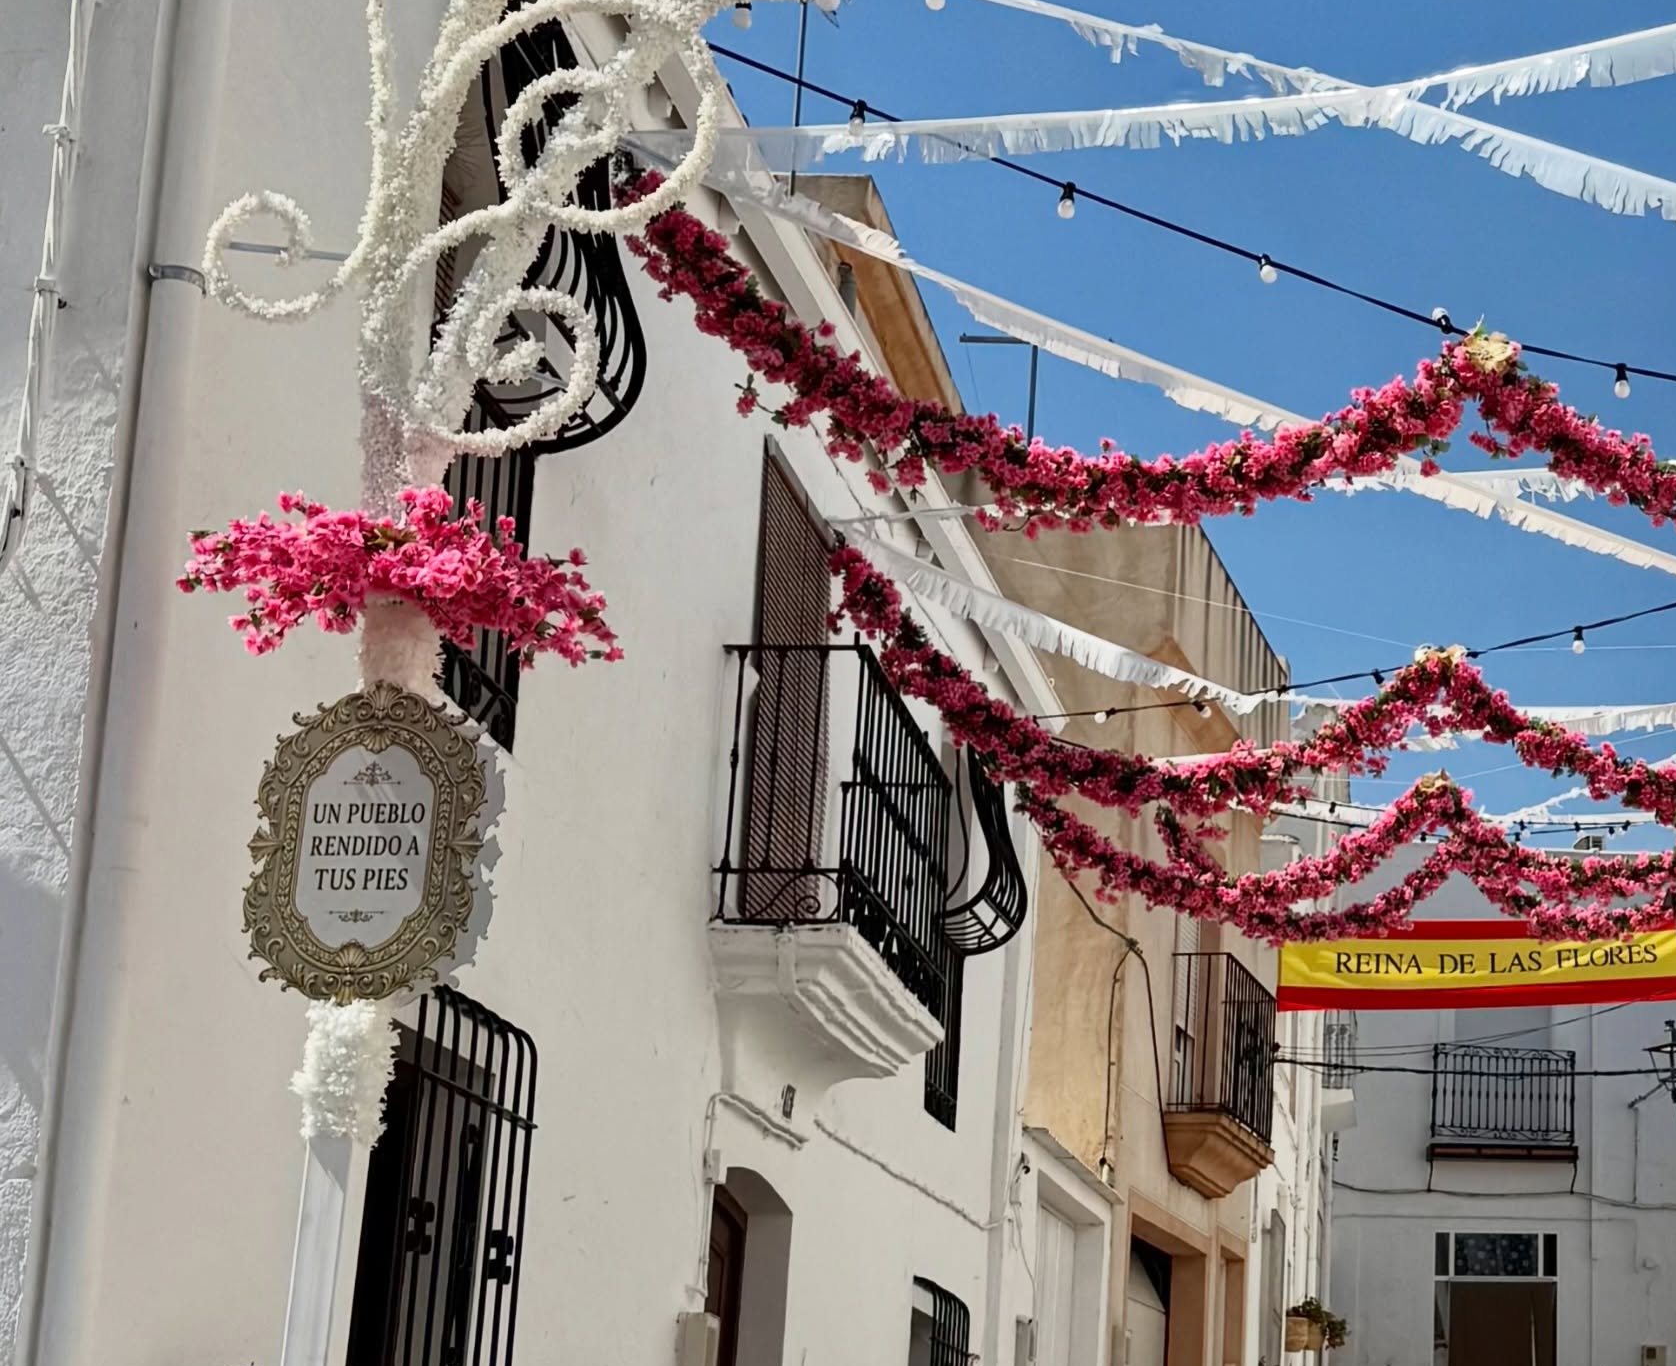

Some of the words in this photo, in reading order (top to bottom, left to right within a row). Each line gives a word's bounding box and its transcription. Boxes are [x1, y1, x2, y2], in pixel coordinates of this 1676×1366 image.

[313, 802, 342, 825] UN
[346, 802, 426, 825] PUEBLO
[309, 835, 401, 857] RENDIDO
[405, 836, 420, 856] A
[314, 868, 357, 891] TUS
[362, 868, 409, 891] PIES
[1335, 951, 1424, 975] REINA
[1438, 953, 1477, 975] DE
[1489, 950, 1543, 973] LAS
[1557, 943, 1658, 968] FLORES
